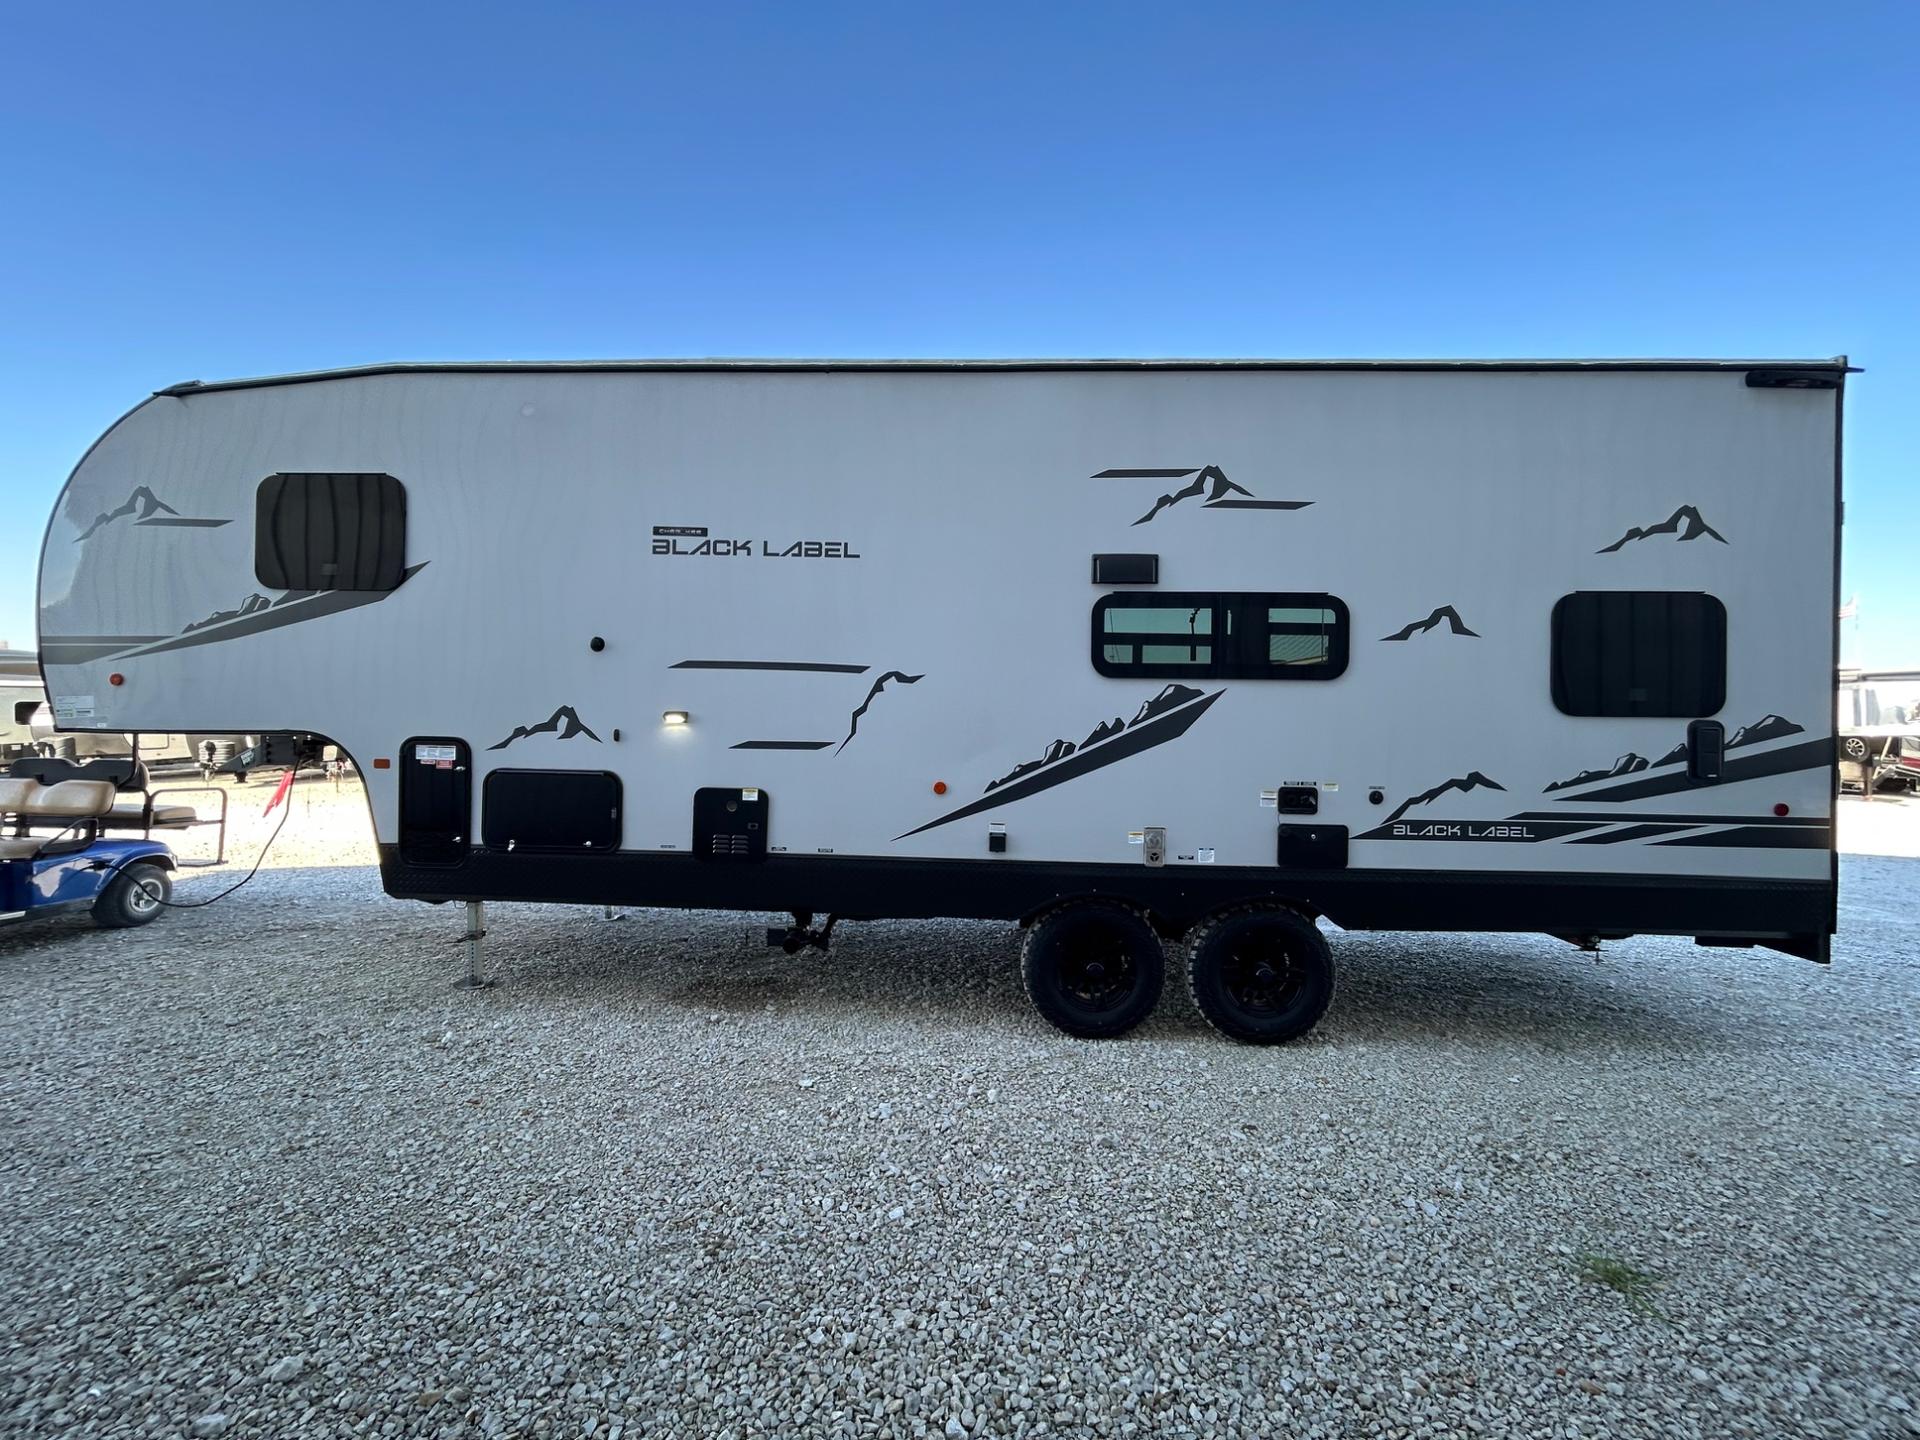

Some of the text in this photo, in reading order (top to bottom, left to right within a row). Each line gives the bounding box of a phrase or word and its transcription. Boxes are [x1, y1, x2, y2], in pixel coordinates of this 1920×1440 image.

[652, 539, 860, 558] BLACK LABEL
[1393, 824, 1535, 838] BLACK LABEL
